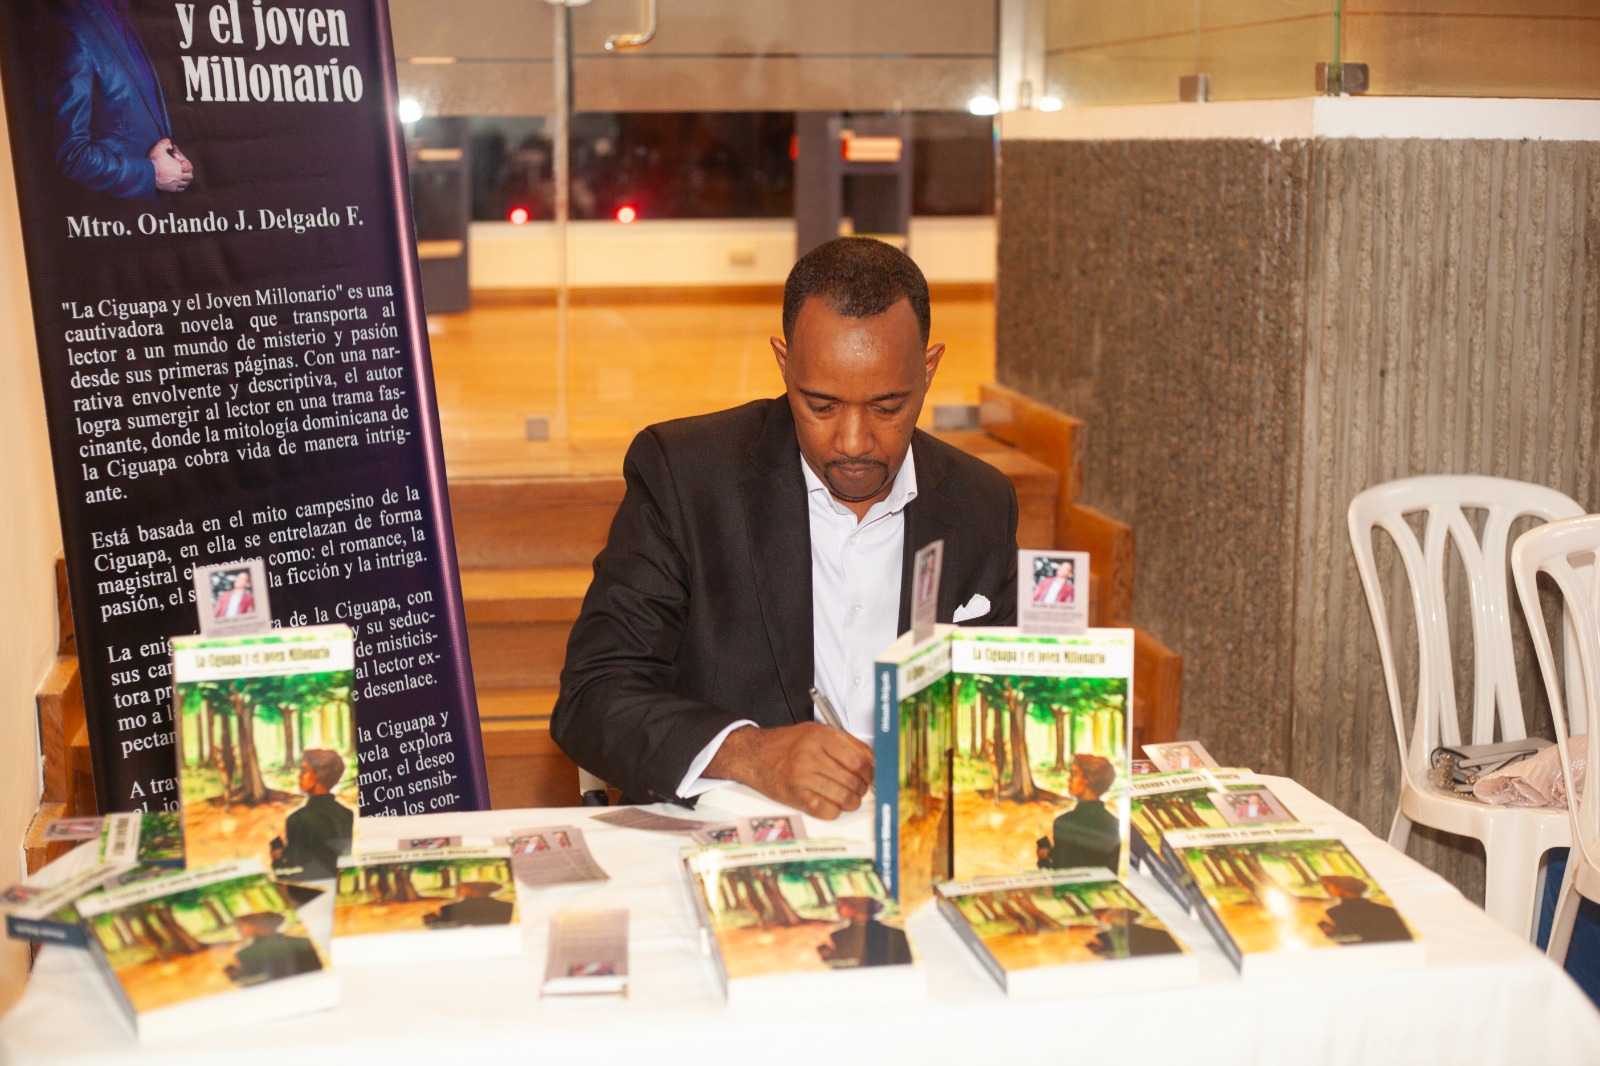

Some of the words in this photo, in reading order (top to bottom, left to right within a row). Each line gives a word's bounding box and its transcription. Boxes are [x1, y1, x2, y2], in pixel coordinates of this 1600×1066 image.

[175, 3, 195, 49] y
[209, 0, 244, 44] el
[252, 0, 350, 51] joven
[181, 55, 363, 103] Millonario
[67, 216, 131, 238] Mtro.
[138, 211, 228, 234] Orlando
[235, 210, 253, 230] J.
[259, 207, 340, 234] Delgado
[346, 206, 363, 226] F.
[62, 302, 94, 319] "La
[98, 299, 168, 320] Ciguapa
[172, 300, 181, 316] y
[187, 293, 201, 310] el
[206, 293, 252, 309] Joven
[255, 284, 342, 305] Millonario"
[348, 287, 363, 299] es
[367, 285, 393, 298] una
[65, 320, 164, 343] cautivadora
[180, 314, 234, 333] novela
[250, 315, 277, 332] que
[293, 306, 368, 326] transporta
[382, 301, 395, 317] al
[67, 348, 117, 365] lector
[126, 348, 136, 360] a
[144, 346, 165, 359] un
[173, 336, 228, 356] mundo
[237, 334, 255, 351] de
[263, 328, 326, 348] misterio
[334, 331, 342, 347] y
[351, 323, 398, 345] pasión
[71, 368, 120, 389] desde
[126, 369, 152, 383] sus
[158, 362, 229, 385] primeras
[234, 354, 298, 377] páginas.
[304, 350, 335, 366] Con
[340, 350, 367, 363] una
[372, 347, 400, 360] nar-
[73, 392, 124, 411] rativa
[132, 383, 221, 405] envolvente
[229, 384, 238, 400] y
[248, 371, 337, 393] descriptiva,
[345, 367, 358, 383] el
[366, 366, 403, 381] autor
[76, 417, 122, 438] logra
[127, 405, 199, 429] sumergir
[206, 402, 220, 420] al
[225, 401, 270, 418] lector
[277, 400, 294, 412] en
[299, 396, 327, 410] una
[332, 391, 374, 406] trama
[379, 385, 405, 401] fas-
[80, 437, 147, 458] cinante,
[151, 428, 200, 449] donde
[205, 426, 220, 442] la
[224, 417, 299, 440] mitología
[302, 409, 388, 431] dominicana
[392, 404, 409, 420] de
[82, 463, 99, 480] la
[107, 458, 177, 479] Ciguapa
[185, 448, 229, 467] cobra
[237, 442, 271, 460] vida
[278, 438, 296, 455] de
[304, 435, 359, 452] manera
[366, 425, 411, 444] intrig-
[86, 486, 127, 504] ante.
[91, 528, 130, 549] Está
[137, 519, 194, 542] basada
[202, 519, 221, 532] en
[230, 510, 243, 528] el
[252, 506, 287, 524] mito
[296, 493, 374, 518] campesino
[382, 488, 398, 505] de
[406, 485, 420, 501] la
[94, 550, 172, 573] Ciguapa,
[180, 545, 199, 558] en
[207, 535, 236, 554] ella
[244, 535, 261, 548] se
[269, 521, 347, 544] entrelazan
[355, 513, 372, 530] de
[380, 509, 422, 526] forma
[97, 565, 178, 595] magistral
[269, 547, 315, 566] como:
[321, 540, 334, 557] el
[340, 533, 406, 554] romance,
[411, 526, 425, 542] la
[100, 594, 164, 622] pasión,
[169, 587, 183, 605] el
[268, 571, 283, 588] la
[287, 562, 340, 584] ficción
[344, 563, 352, 579] y
[358, 556, 372, 572] la
[376, 549, 427, 569] intriga.
[107, 646, 132, 663] La
[289, 611, 307, 627] de
[314, 607, 329, 623] la
[335, 597, 401, 620] Ciguapa,
[407, 591, 433, 605] con
[111, 669, 140, 686] sus
[367, 621, 383, 634] su
[389, 610, 435, 630] seduc-
[114, 691, 151, 708] tora
[356, 641, 373, 658] de
[376, 629, 438, 653] misticis-
[118, 715, 146, 731] mo
[152, 712, 162, 724] a
[356, 661, 368, 679] al
[373, 656, 414, 675] lector
[419, 653, 440, 665] ex-
[364, 674, 437, 699] desenlace.
[130, 781, 145, 799] A
[358, 727, 372, 743] la
[377, 715, 436, 738] Ciguapa
[440, 712, 448, 727] y
[397, 758, 410, 776] el
[416, 752, 454, 774] deseo
[400, 732, 452, 754] explora
[374, 786, 404, 802] Con
[408, 770, 457, 794] sensib-
[403, 800, 426, 816] los
[430, 793, 460, 809] con-
